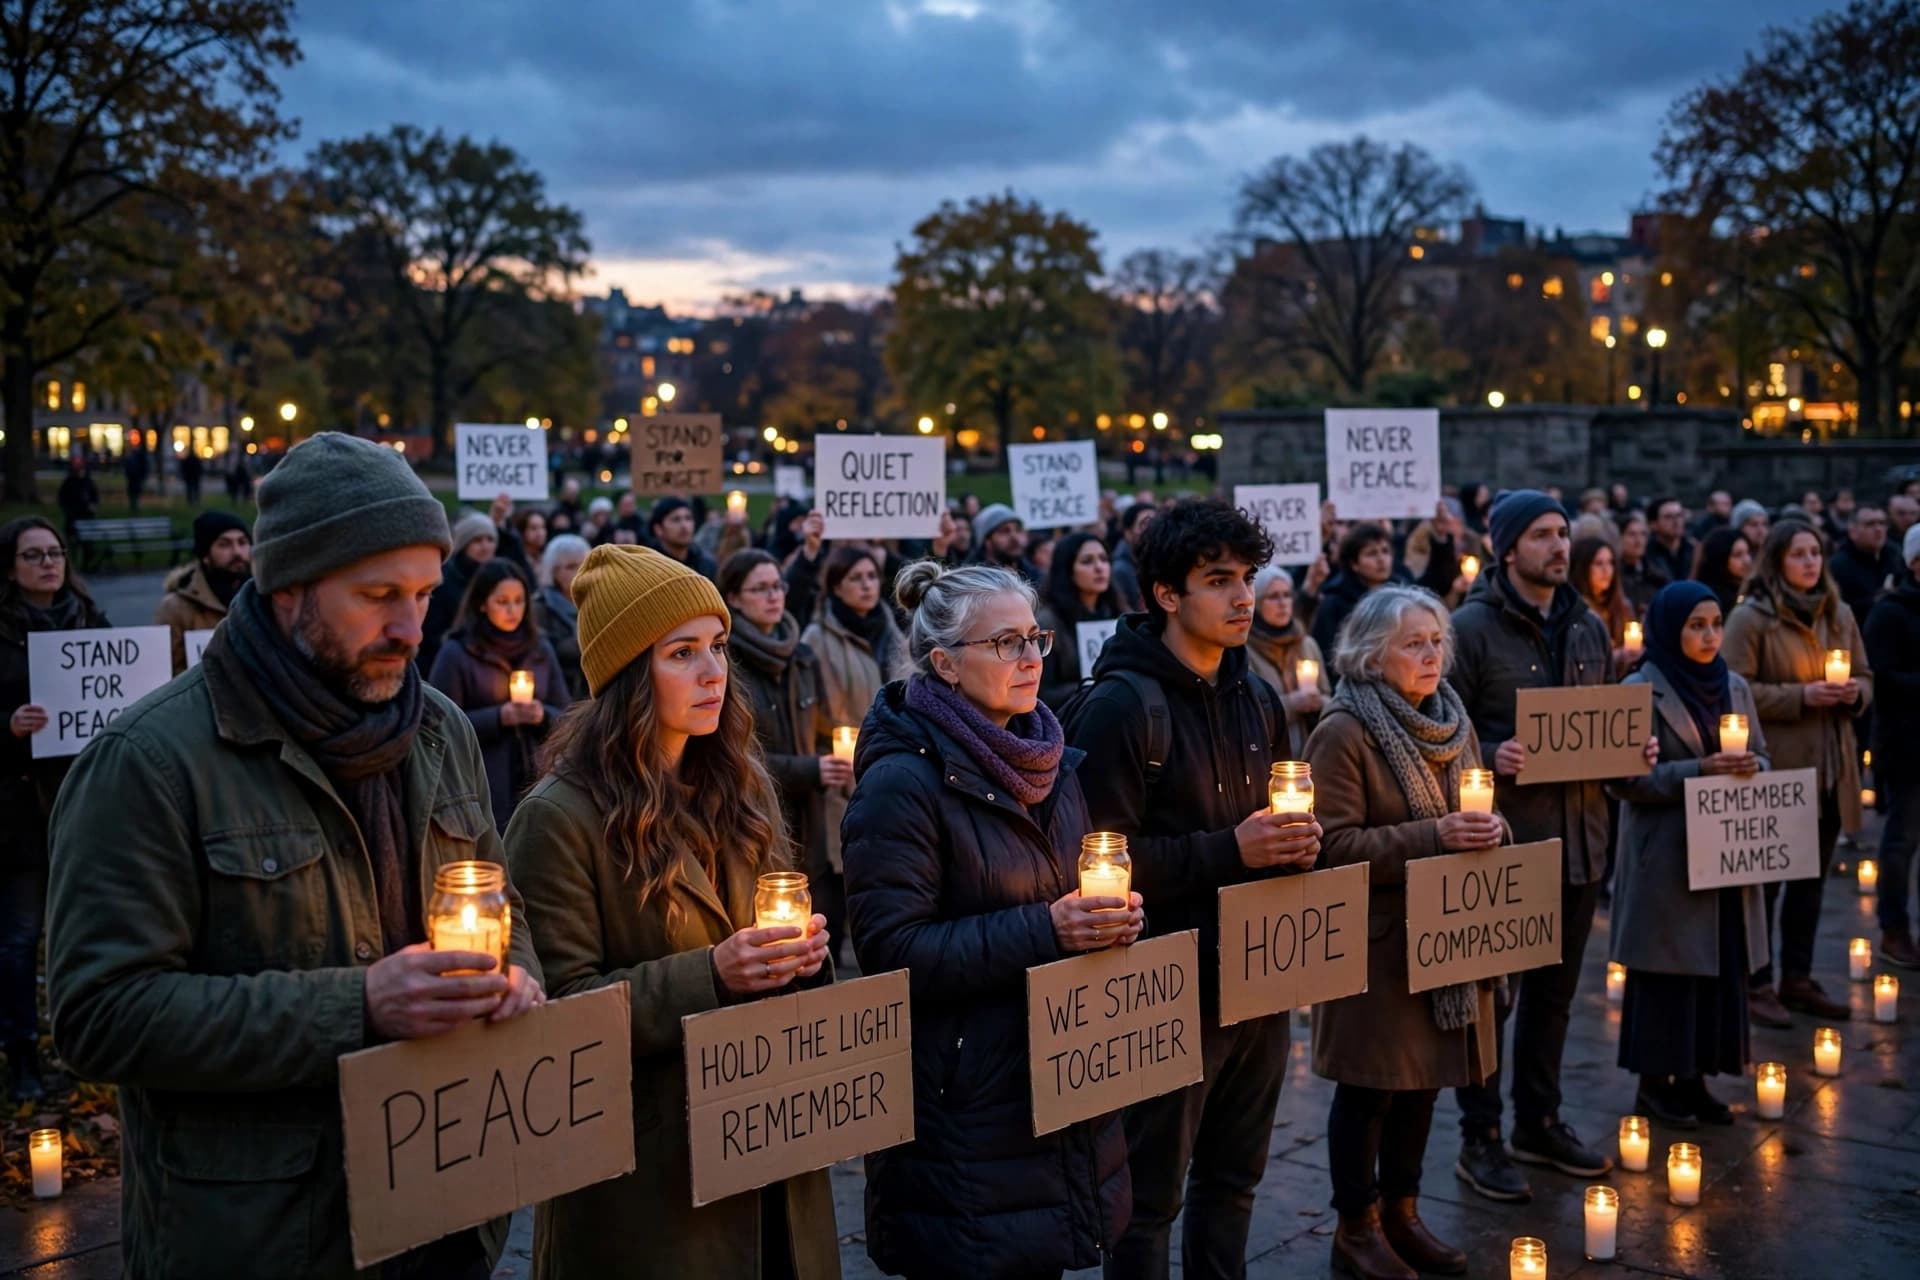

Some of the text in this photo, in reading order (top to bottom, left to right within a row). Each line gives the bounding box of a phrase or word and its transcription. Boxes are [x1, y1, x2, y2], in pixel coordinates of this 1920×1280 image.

[467, 434, 532, 458] NEVER
[646, 424, 712, 449] STAND
[1347, 426, 1412, 452] NEVER
[466, 463, 538, 486] FORGET
[841, 451, 913, 482] QUIET
[1022, 452, 1082, 475] STAND
[1351, 460, 1416, 488] PEACE
[825, 490, 939, 517] REFLECTION
[1029, 495, 1086, 520] PEACE
[61, 639, 139, 669] STAND
[82, 674, 124, 700] FOR
[59, 707, 128, 741] PEAC
[1527, 707, 1642, 754] JUSTICE
[1698, 782, 1807, 815] REMEMBER
[1720, 815, 1780, 842] THEIR
[1720, 844, 1790, 875] NAMES
[1443, 864, 1523, 915] LOVE
[1244, 902, 1346, 981] HOPE
[1417, 912, 1553, 967] COMPASSION
[1046, 963, 1184, 1035] WE STAND
[702, 1001, 904, 1090] HOLD THE LIGHT
[1047, 1018, 1187, 1096] TOGETHER
[382, 1041, 604, 1190] PEACE
[722, 1071, 888, 1160] REMEMBER
